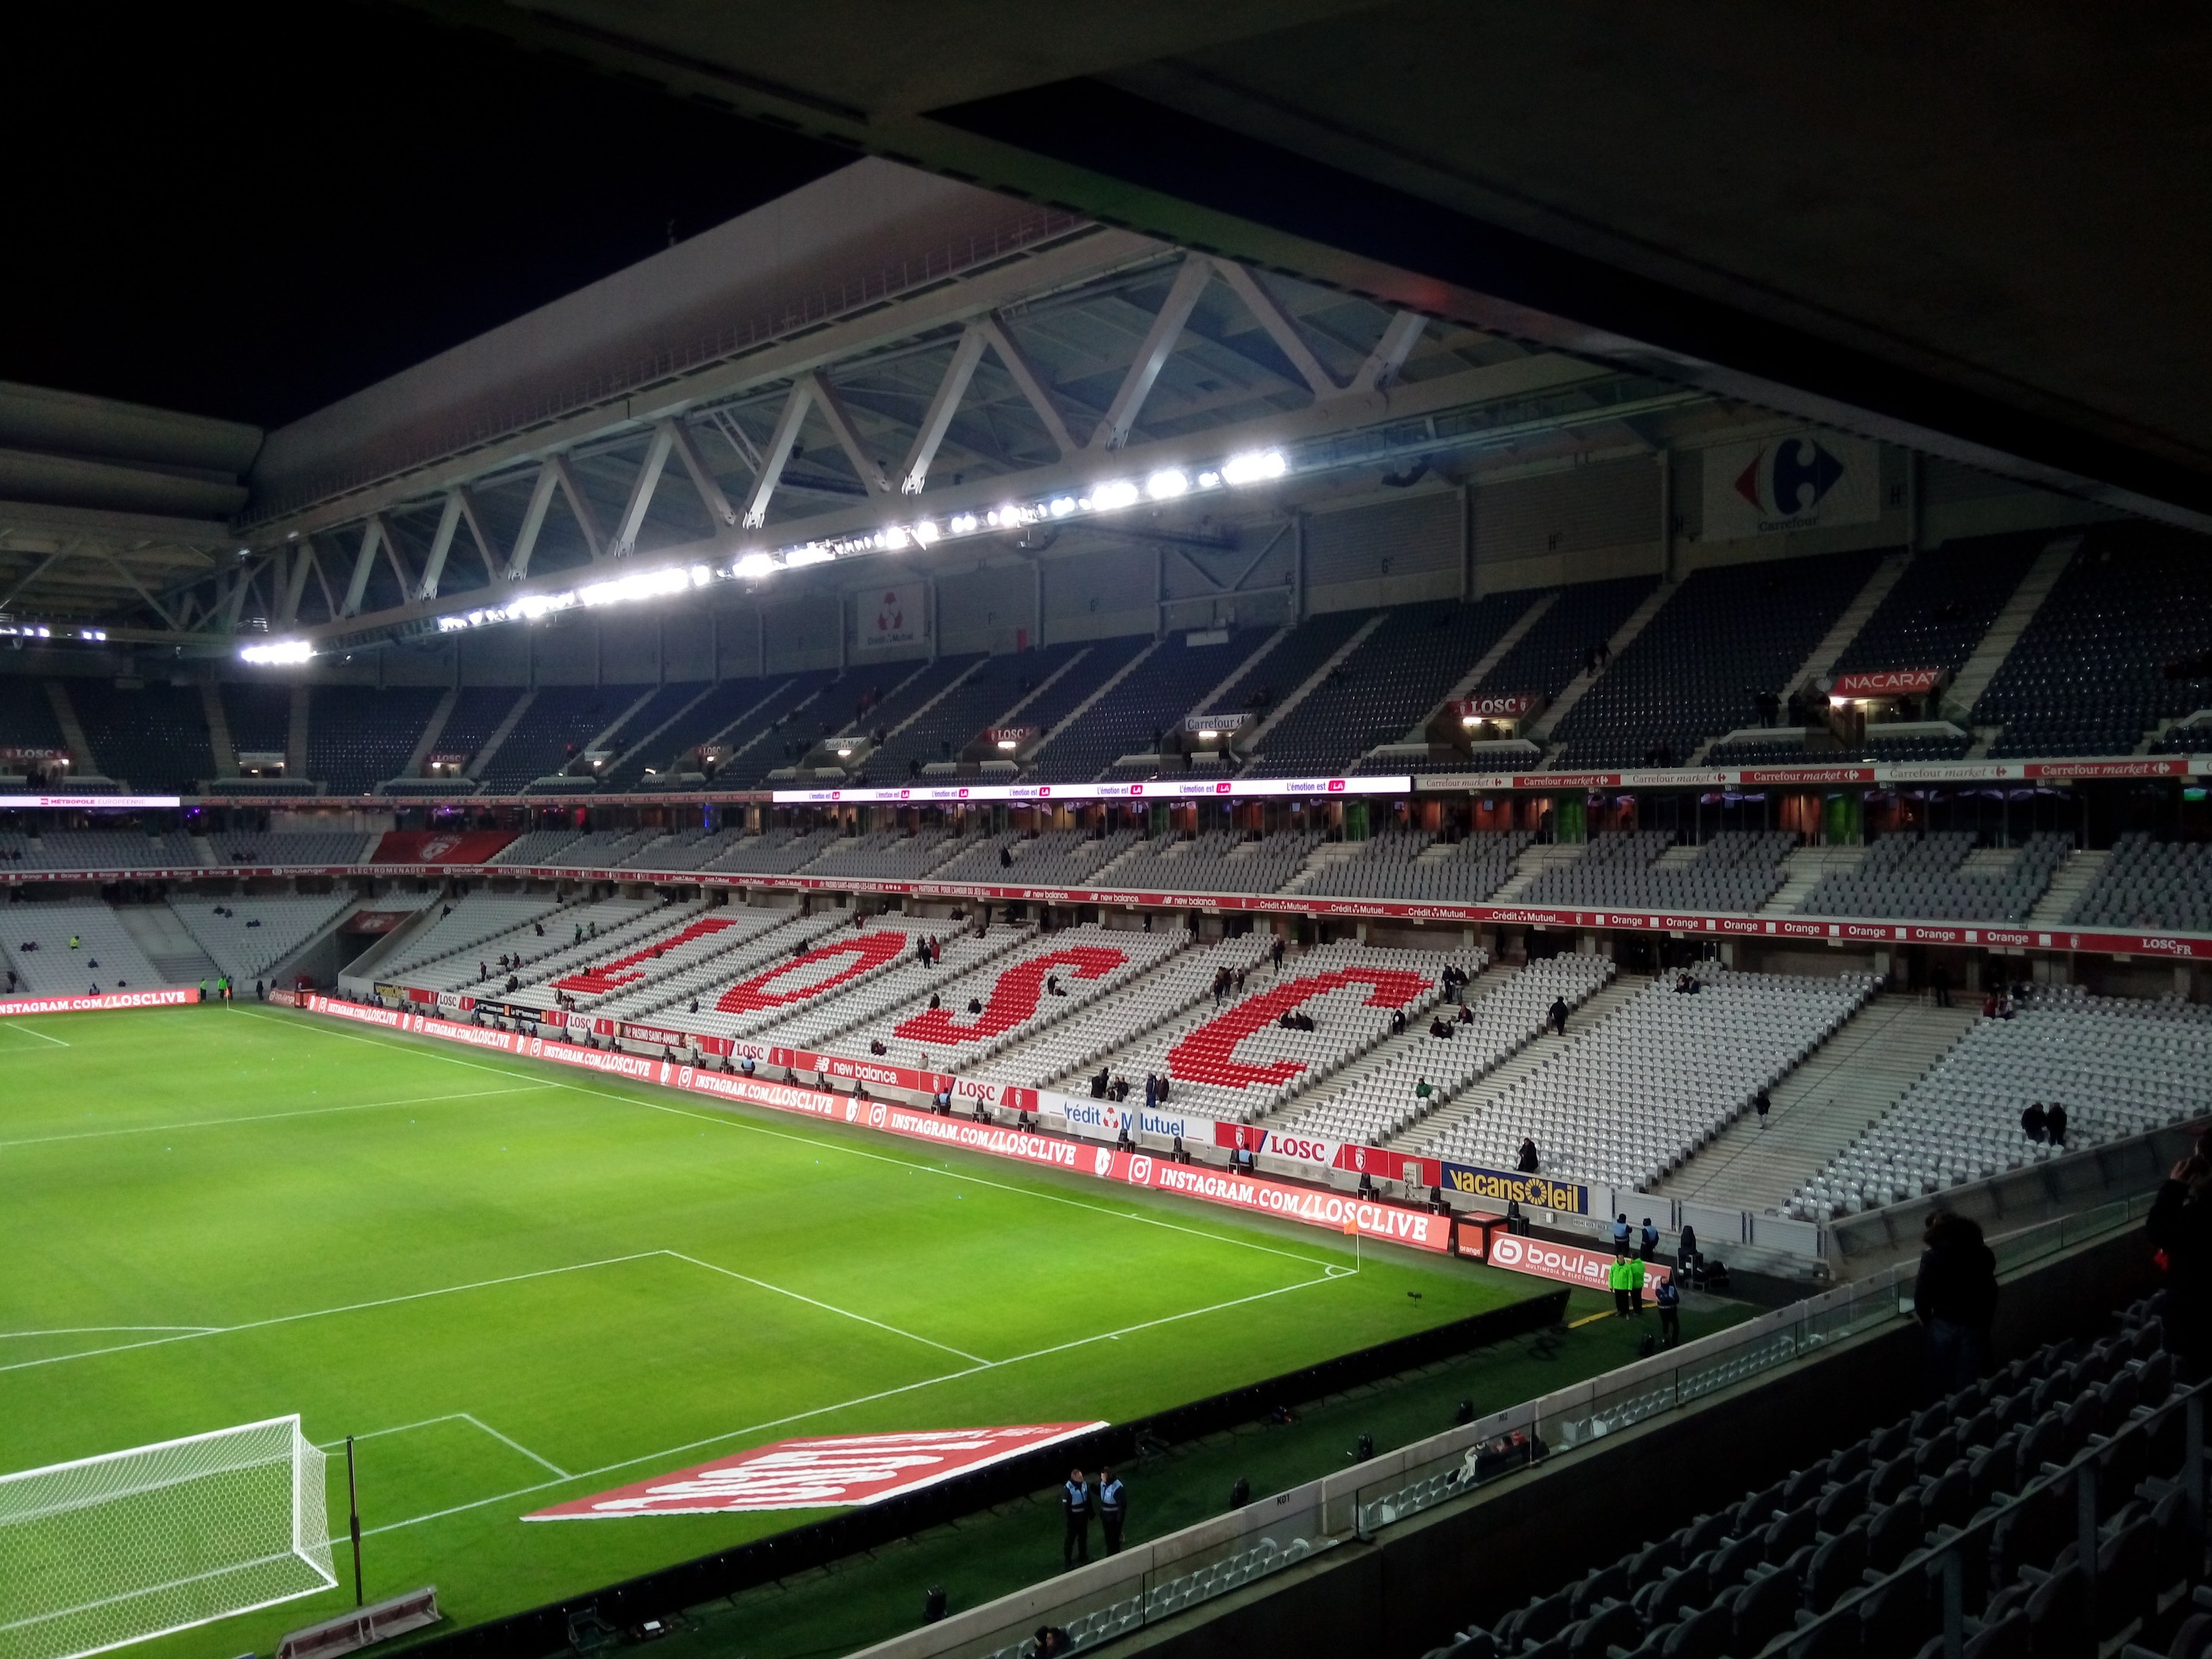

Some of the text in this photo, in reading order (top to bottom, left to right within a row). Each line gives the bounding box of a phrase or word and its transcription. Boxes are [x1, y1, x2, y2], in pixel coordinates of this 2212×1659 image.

[1759, 515, 1819, 532] Carrefour
[1845, 672, 1937, 690] NACARAT
[1471, 699, 1516, 714] LOSC
[1187, 716, 1234, 730] Carrefour
[998, 728, 1024, 740] LOSC
[16, 749, 54, 759] LOSC
[437, 754, 461, 763] LOSC
[1753, 770, 1842, 781] Carrefour market
[1889, 767, 1987, 778] Carrefour market
[2041, 763, 2149, 777] Carrefour market
[1426, 777, 1488, 787] Carrefour market
[1524, 776, 1594, 786] Carrefour market
[1633, 773, 1711, 783] Carrefour market
[1260, 901, 1310, 911] Crédit Mutuel
[1330, 904, 1384, 915] Crédit Mutuel
[1408, 907, 1466, 919] Crédit Mutuel
[1492, 910, 1556, 922] Crédit Mutuel
[1611, 916, 1643, 926] Orange
[1666, 918, 1699, 928] Orange
[1724, 920, 1758, 931] Orange
[1784, 923, 1820, 934] Orange
[1848, 926, 1886, 937] Orange
[1916, 929, 1955, 940] Orange
[1987, 932, 2028, 943] Orange
[0, 992, 186, 1014] NSTAGRAM.COM/LOSCLIVE
[439, 995, 457, 1007] LOSC
[328, 1002, 398, 1025] INSTAGRAM.COM/LOSCLIVE
[570, 1015, 591, 1029] LOSC
[424, 1022, 510, 1049] INSTAGRAM.COM/LOSCLIVE
[737, 1043, 764, 1061] LOSC
[543, 1045, 651, 1078] INSTAGRAM.COM/LOSCLIVE
[833, 1062, 853, 1076] new
[694, 1074, 833, 1114] INSTAGRAM.COM/LOSCLIVE
[959, 1081, 995, 1101] LOSC
[1065, 1100, 1101, 1126] rédit
[891, 1113, 1075, 1165] INSTAGRAM.COM/LOSCLIVE
[1271, 1135, 1325, 1162] LOSC
[1160, 1167, 1429, 1242] INSTAGRAM.COM/LOSCLIVE
[1459, 1245, 1480, 1255] orange
[1525, 1263, 1560, 1276] MULTIMEDIA
[1527, 1243, 1662, 1290] boulaner
